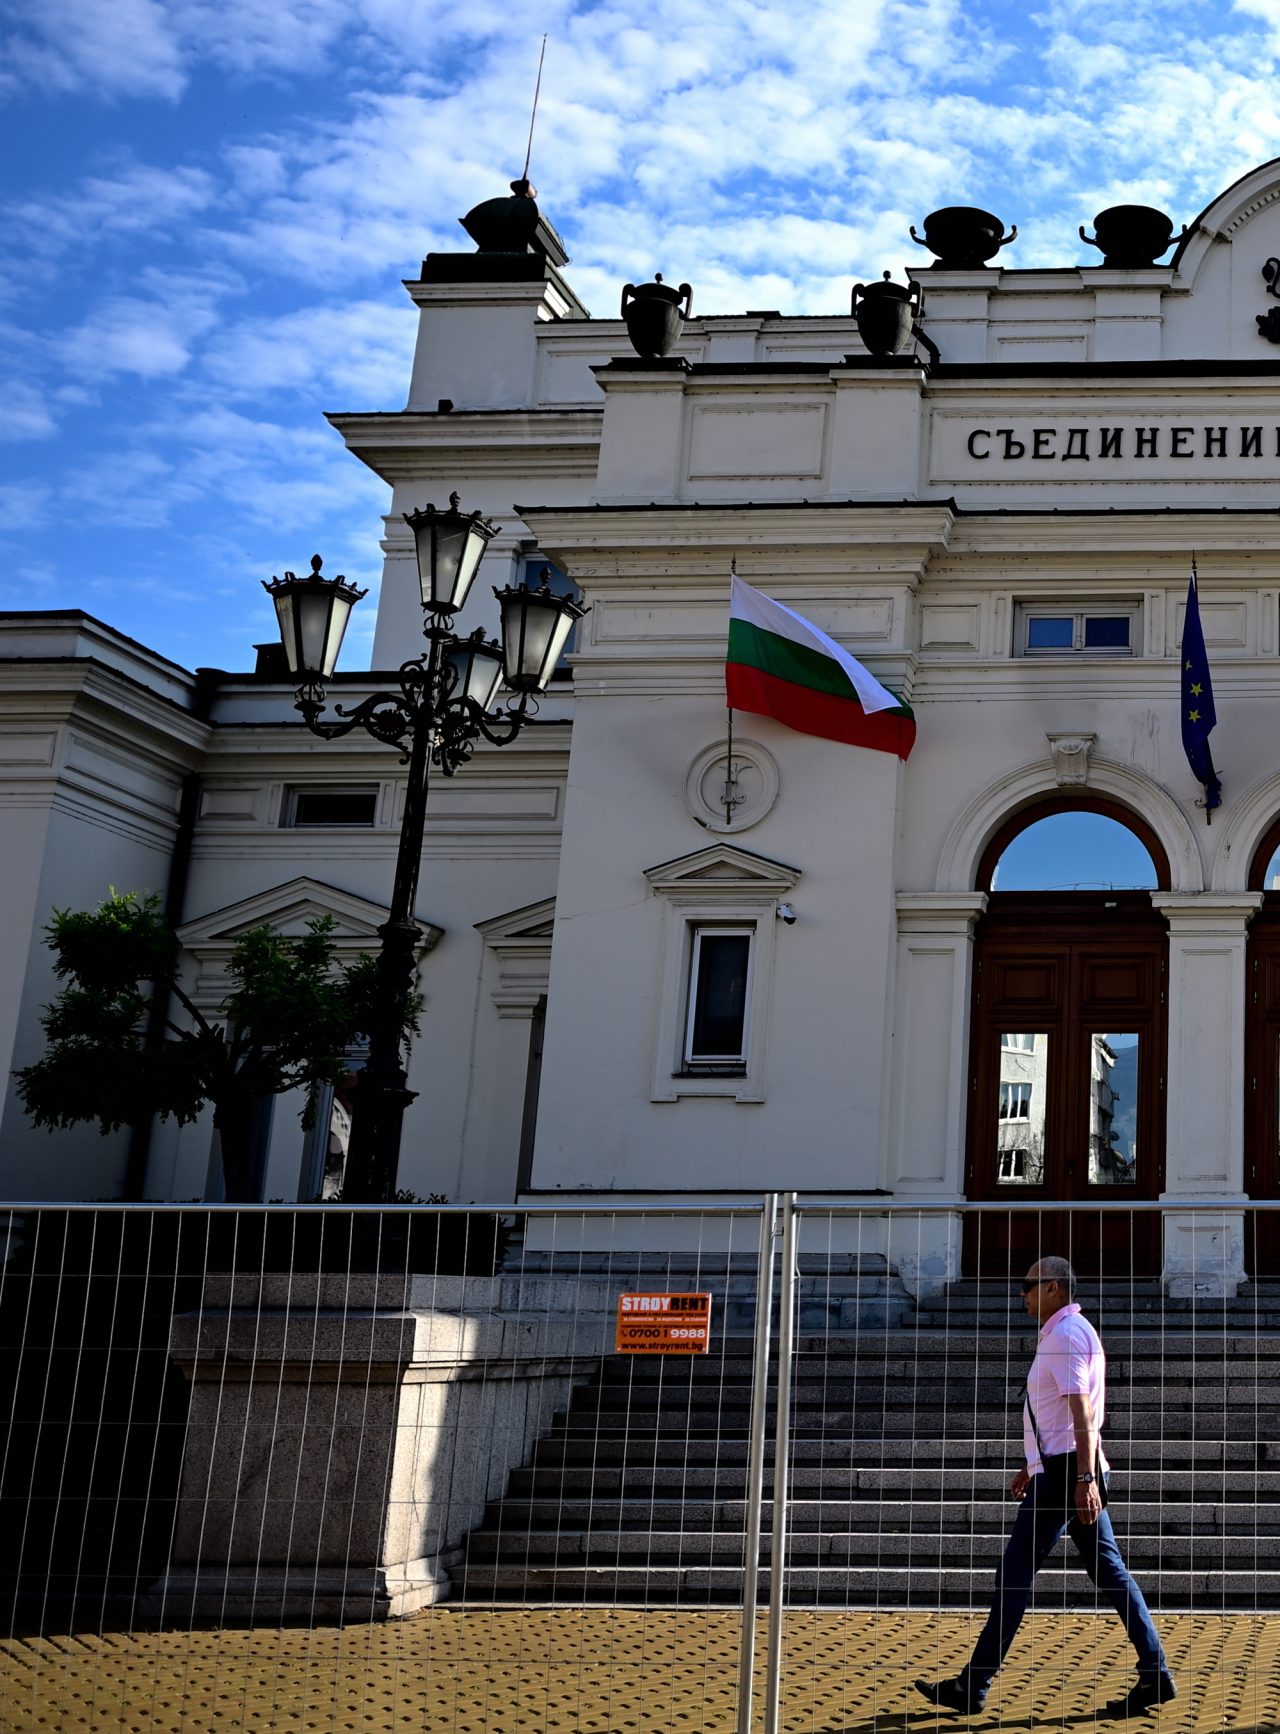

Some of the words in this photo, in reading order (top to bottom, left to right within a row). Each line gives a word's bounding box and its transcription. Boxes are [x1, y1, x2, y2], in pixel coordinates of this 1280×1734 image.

[621, 1297, 708, 1311] STROYRENT
[629, 1329, 660, 1338] 0700
[621, 1342, 703, 1351] www.stroyrent.bg
